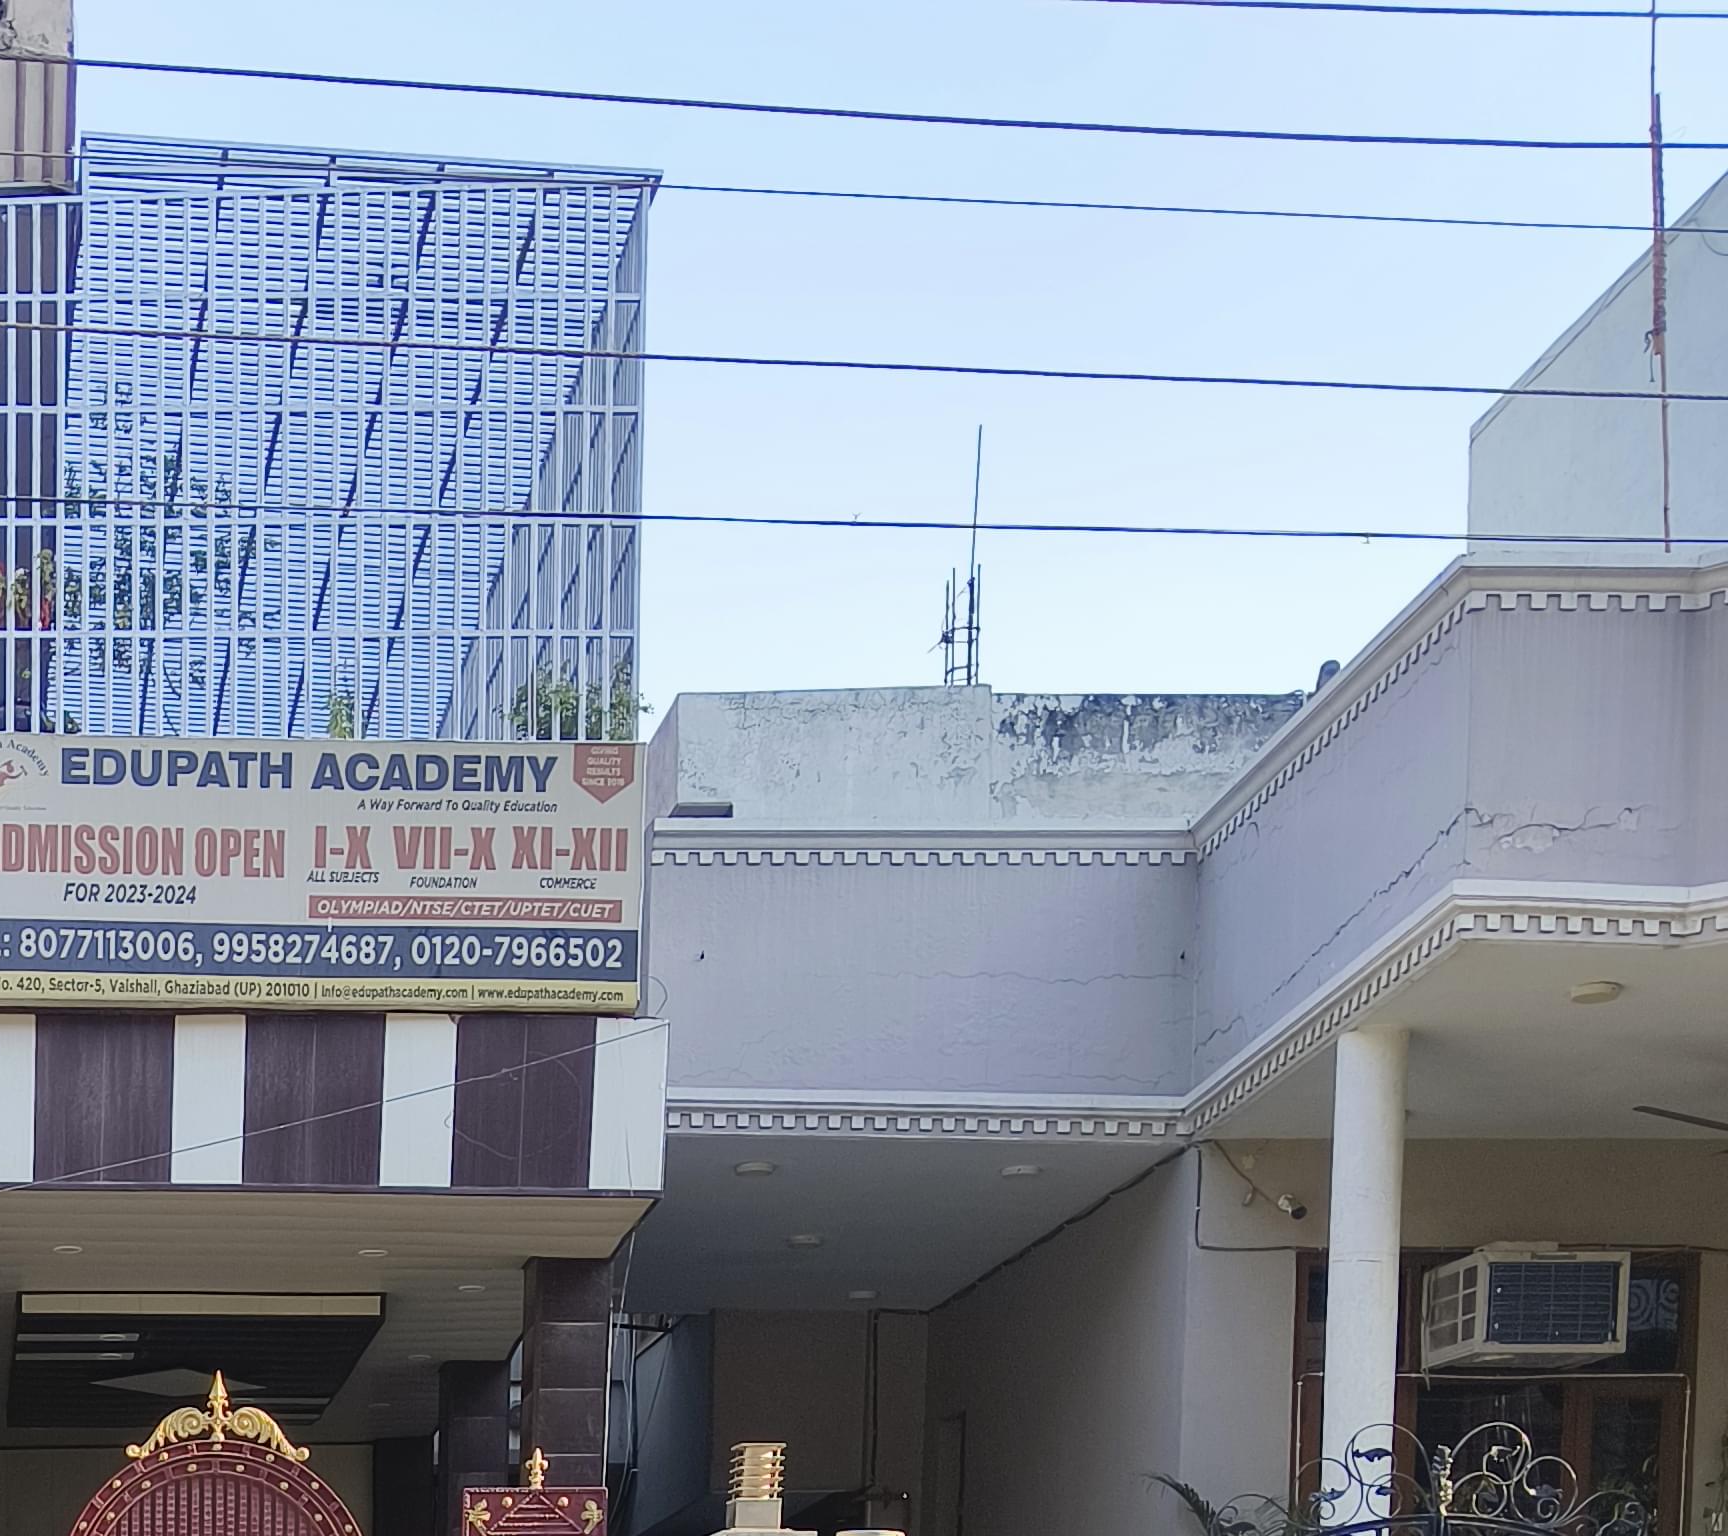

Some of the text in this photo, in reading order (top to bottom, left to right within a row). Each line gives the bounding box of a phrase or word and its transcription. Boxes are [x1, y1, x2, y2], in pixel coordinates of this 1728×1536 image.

[7, 738, 50, 777] Academy
[61, 748, 558, 793] EDUPATH ACADEMY
[357, 798, 558, 813] A Way Forward To Quality Education
[194, 827, 286, 878] OPEN
[314, 825, 629, 872] I-X VII-X XI-XII
[306, 871, 379, 883] ALL SUBJECTS
[409, 876, 478, 889] FOUNDATION
[539, 877, 598, 889] COMMERCE
[63, 882, 197, 905] FOR 2023-2024
[317, 898, 614, 919] OLYMPIAD/NTSE/CTET/UPTET/CUET
[19, 927, 203, 967] 8077113006,
[213, 931, 402, 971] 9958274687,
[411, 934, 623, 969] 0120-7966502
[16, 977, 45, 993] 420,
[49, 977, 105, 995] Sector-5,
[164, 979, 231, 996] Ghaziabad
[234, 981, 262, 998] (UP)
[265, 982, 310, 997] 201010
[477, 986, 624, 1003] www.edupathacademy.com
